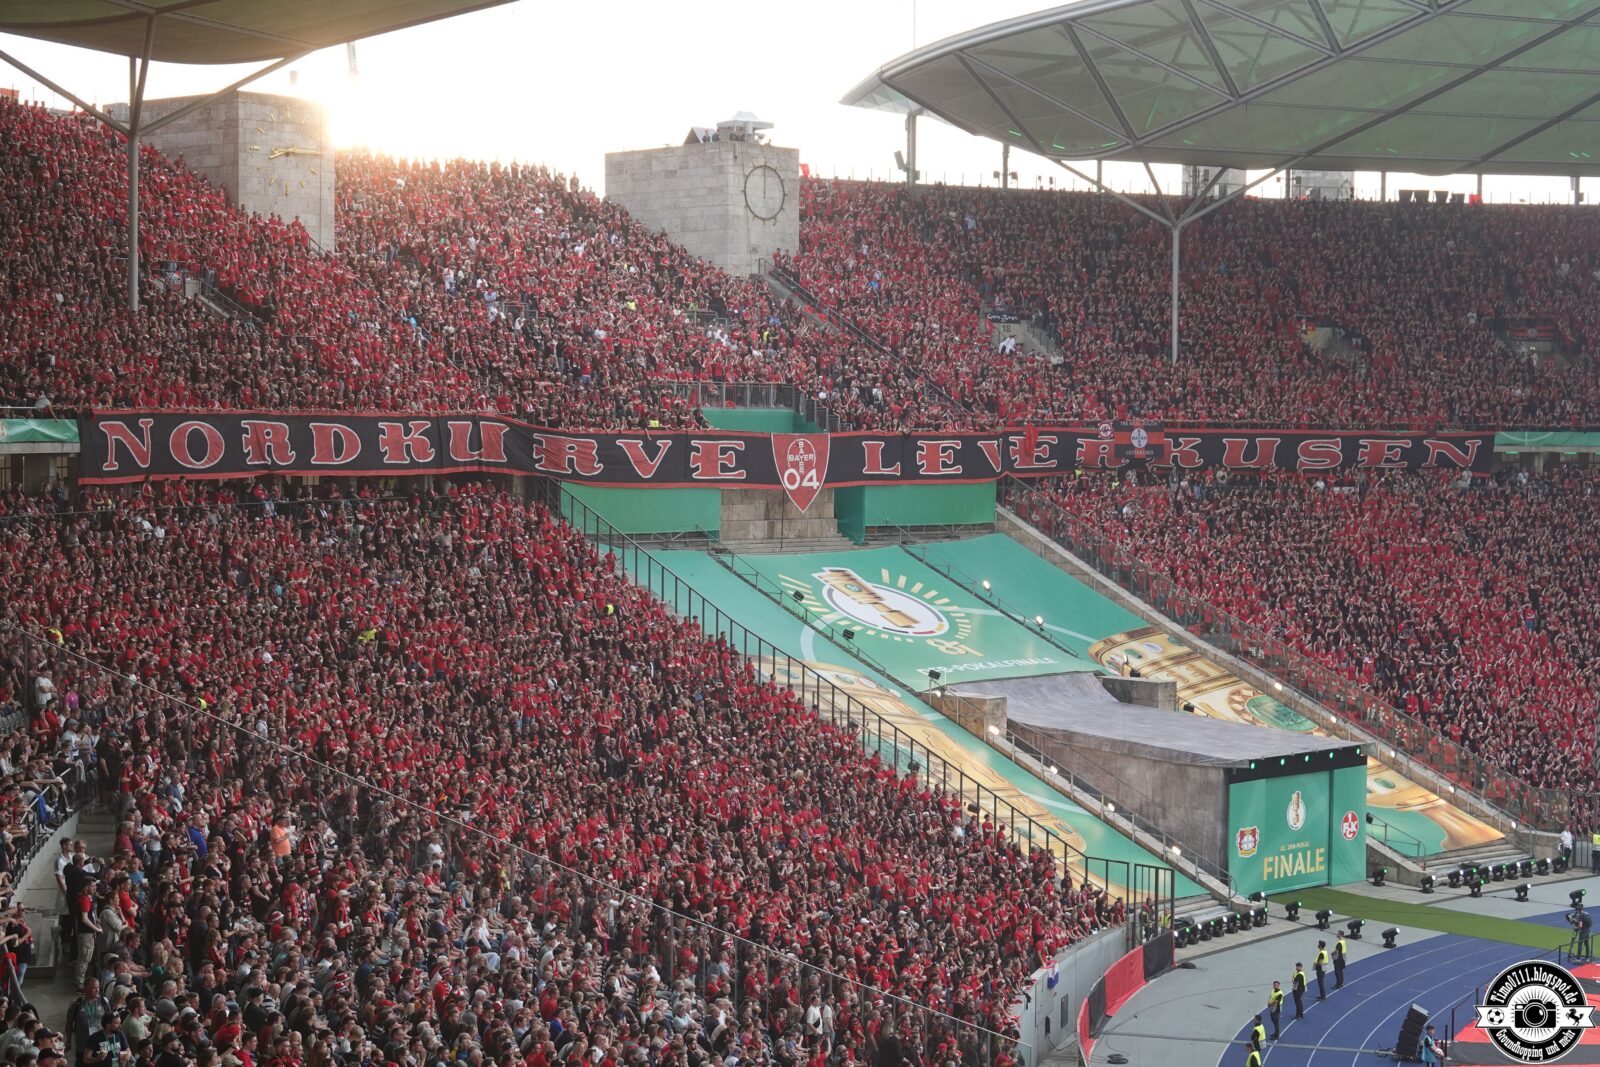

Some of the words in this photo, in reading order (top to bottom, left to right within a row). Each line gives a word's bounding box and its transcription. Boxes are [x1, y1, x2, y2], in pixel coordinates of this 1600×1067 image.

[1002, 325, 1011, 333] 18
[99, 418, 747, 480] NORDKURVE
[862, 437, 1482, 475] LEVERKUSEN
[788, 453, 815, 462] BAYER
[783, 467, 820, 491] 04
[1263, 847, 1326, 881] FINALE
